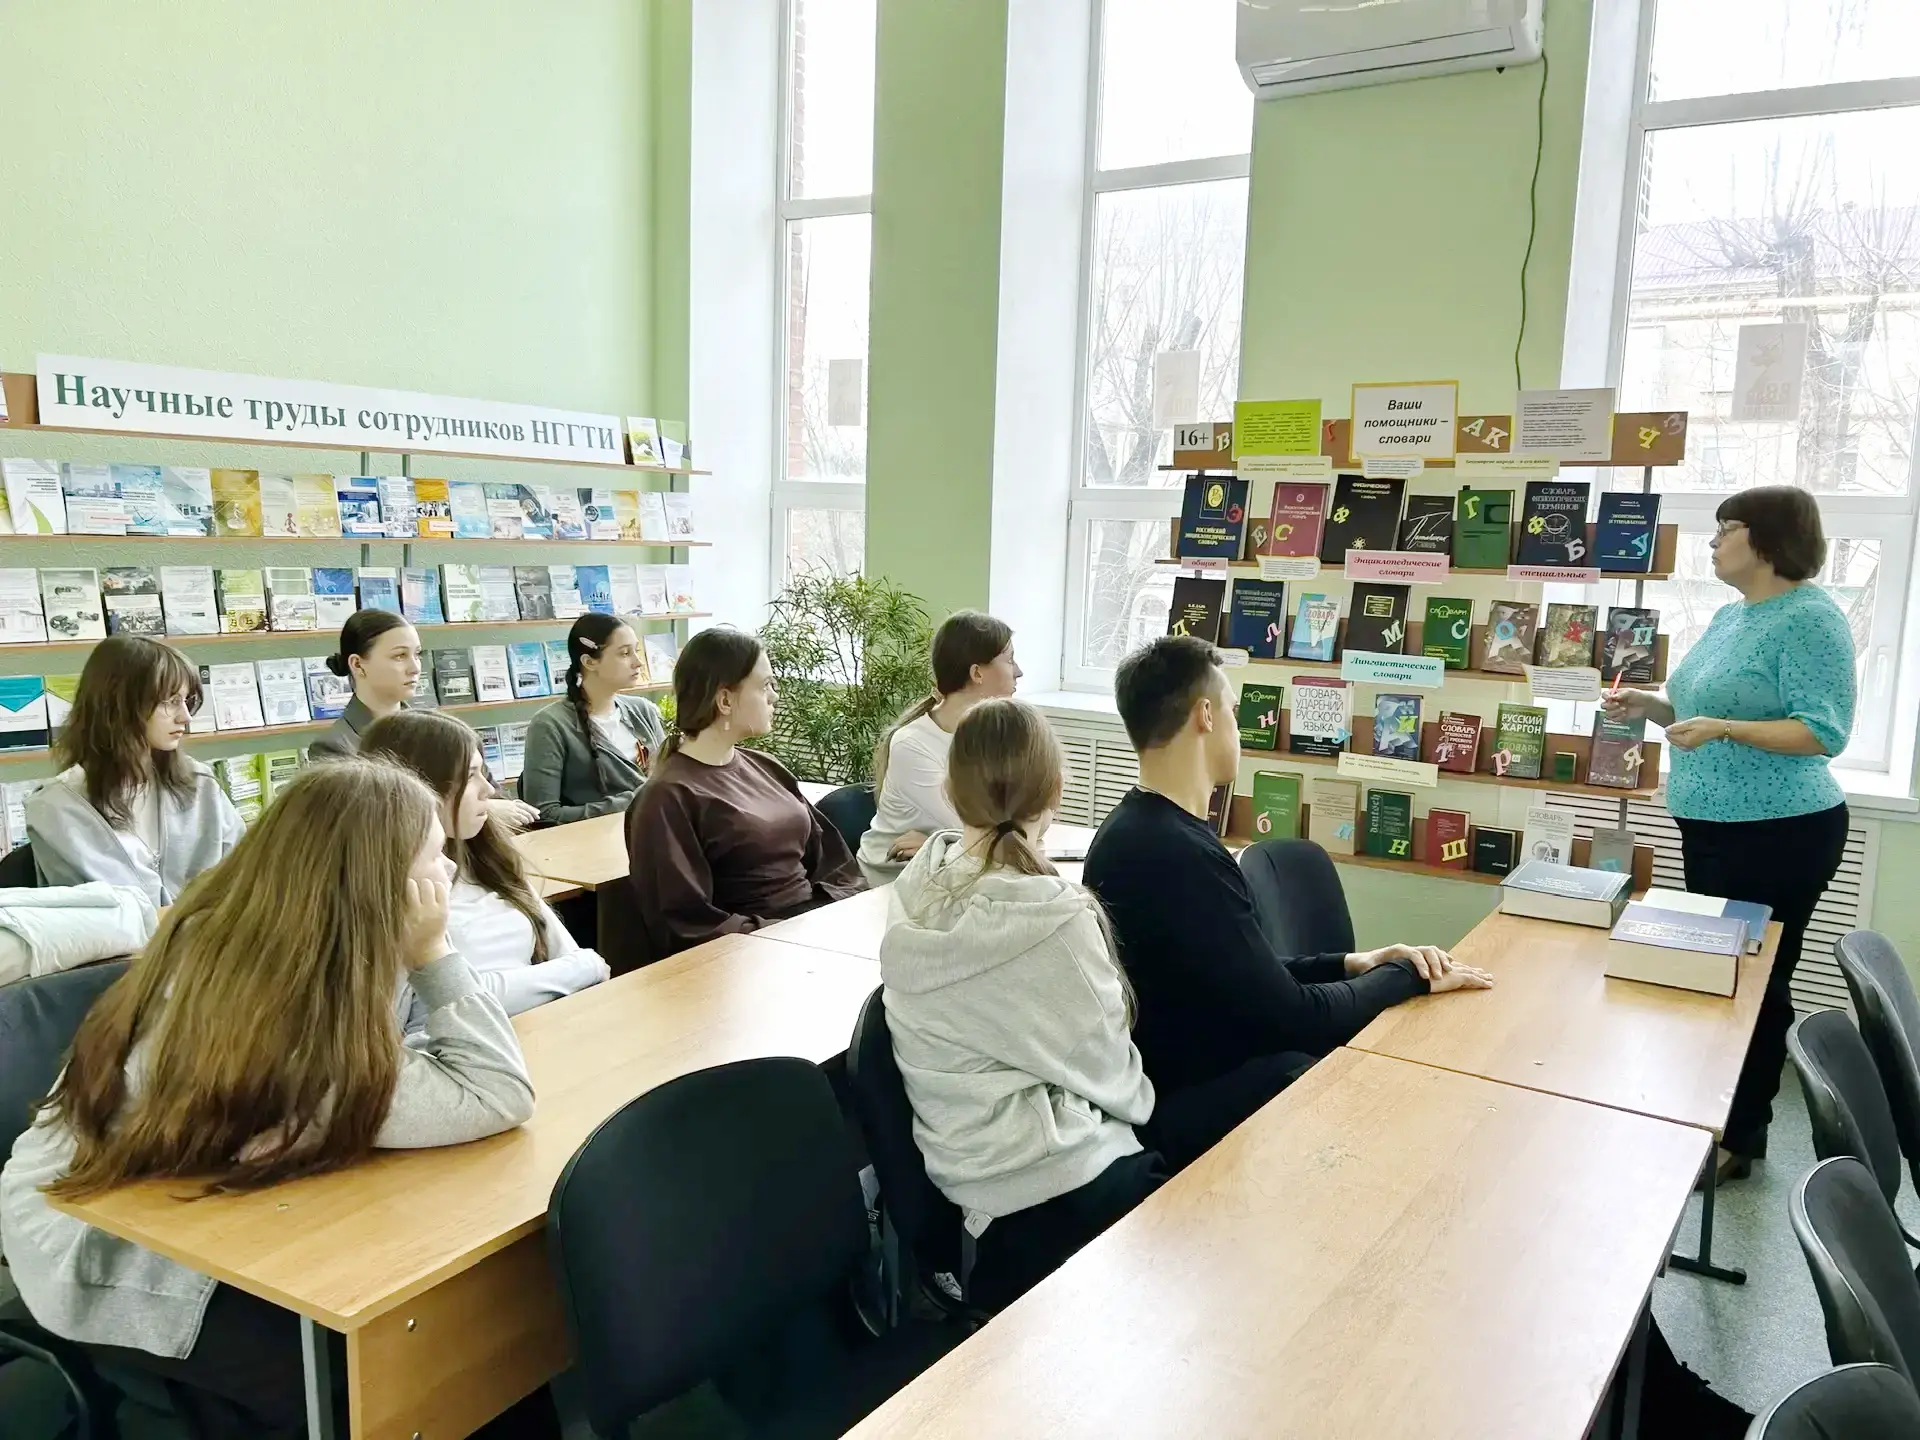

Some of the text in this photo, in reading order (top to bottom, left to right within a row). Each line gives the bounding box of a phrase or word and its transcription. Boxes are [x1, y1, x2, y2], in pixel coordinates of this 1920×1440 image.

[1387, 399, 1423, 411] Ваши
[54, 373, 616, 450] Научные труды сотрудников НГГТИ
[1364, 418, 1438, 429] помощники
[1178, 428, 1210, 446] 16+
[1378, 434, 1432, 446] словари
[1541, 487, 1577, 496] СЛОВАРЬ
[1536, 502, 1580, 511] ТЕРМИНОВ
[1564, 537, 1586, 562] Б
[1191, 559, 1217, 569] общие
[1353, 556, 1443, 568] Энциклопедические
[1378, 569, 1415, 578] словари
[1519, 568, 1587, 580] специальные
[1381, 619, 1404, 648] М
[1350, 656, 1437, 671] Лингвистические
[1373, 671, 1412, 681] словари
[1298, 687, 1342, 700] СЛОВАРЬ
[1296, 698, 1344, 712] УДАРЕНИЙ
[1295, 709, 1343, 723] РУССКОГО
[1501, 713, 1543, 725] РУССКИЙ
[1302, 721, 1335, 733] ЯЗЫКА
[1440, 724, 1476, 735] СЛОВАРЬ
[1500, 722, 1542, 734] ЖАРГОН
[1497, 741, 1539, 754] СЛОВАРЬ
[1528, 811, 1564, 822] СЛОВАРЬ
